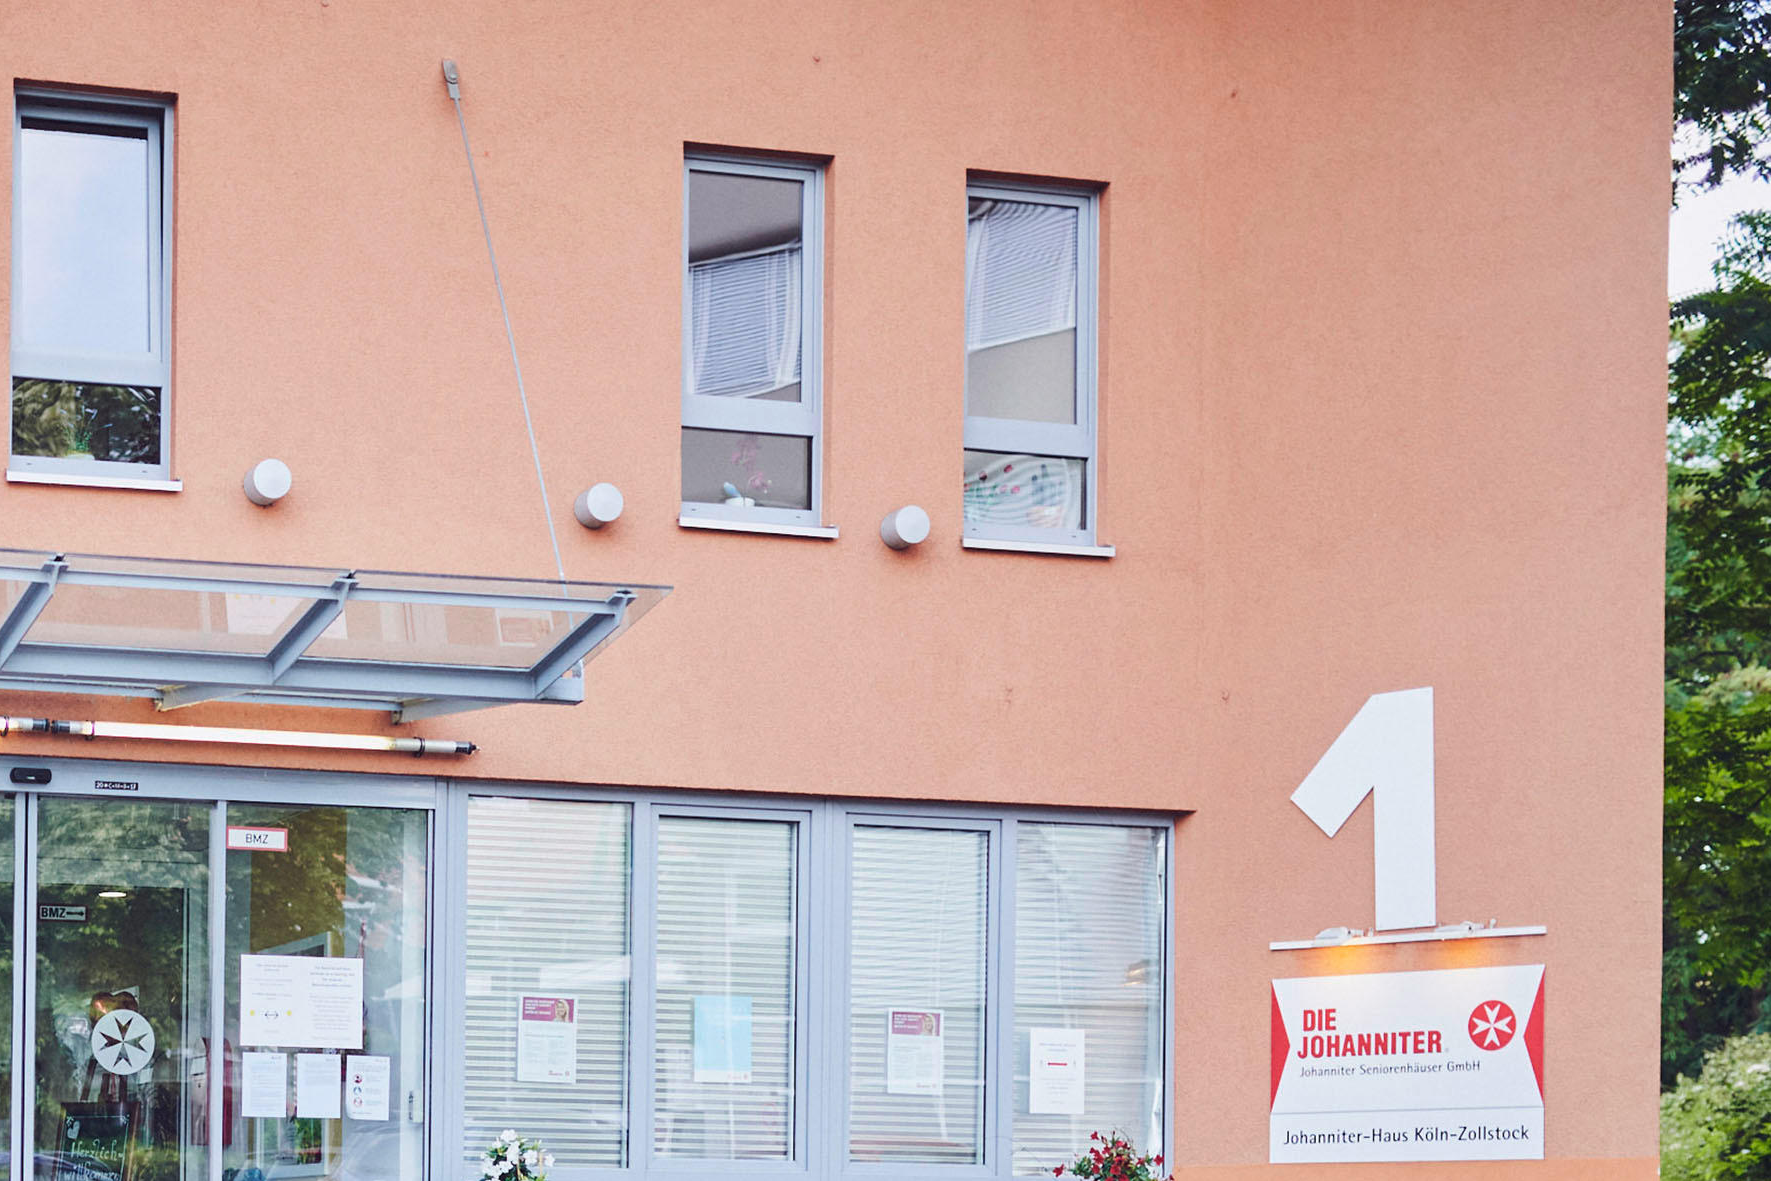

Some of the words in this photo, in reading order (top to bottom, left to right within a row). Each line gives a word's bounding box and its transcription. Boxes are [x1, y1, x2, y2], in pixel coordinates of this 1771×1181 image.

[1290, 686, 1437, 932] 1
[245, 832, 269, 845] BMZ
[40, 906, 66, 919] BMZ
[1303, 1008, 1337, 1032] DIE
[1297, 1030, 1443, 1059] JOHANNITER
[1299, 1064, 1355, 1078] Johanniter
[1359, 1061, 1442, 1075] Seniorenhäuser
[1446, 1060, 1480, 1073] GmbH
[1283, 1128, 1409, 1146] Johanniter-Haus
[1414, 1124, 1529, 1143] Köln-Zollstock
